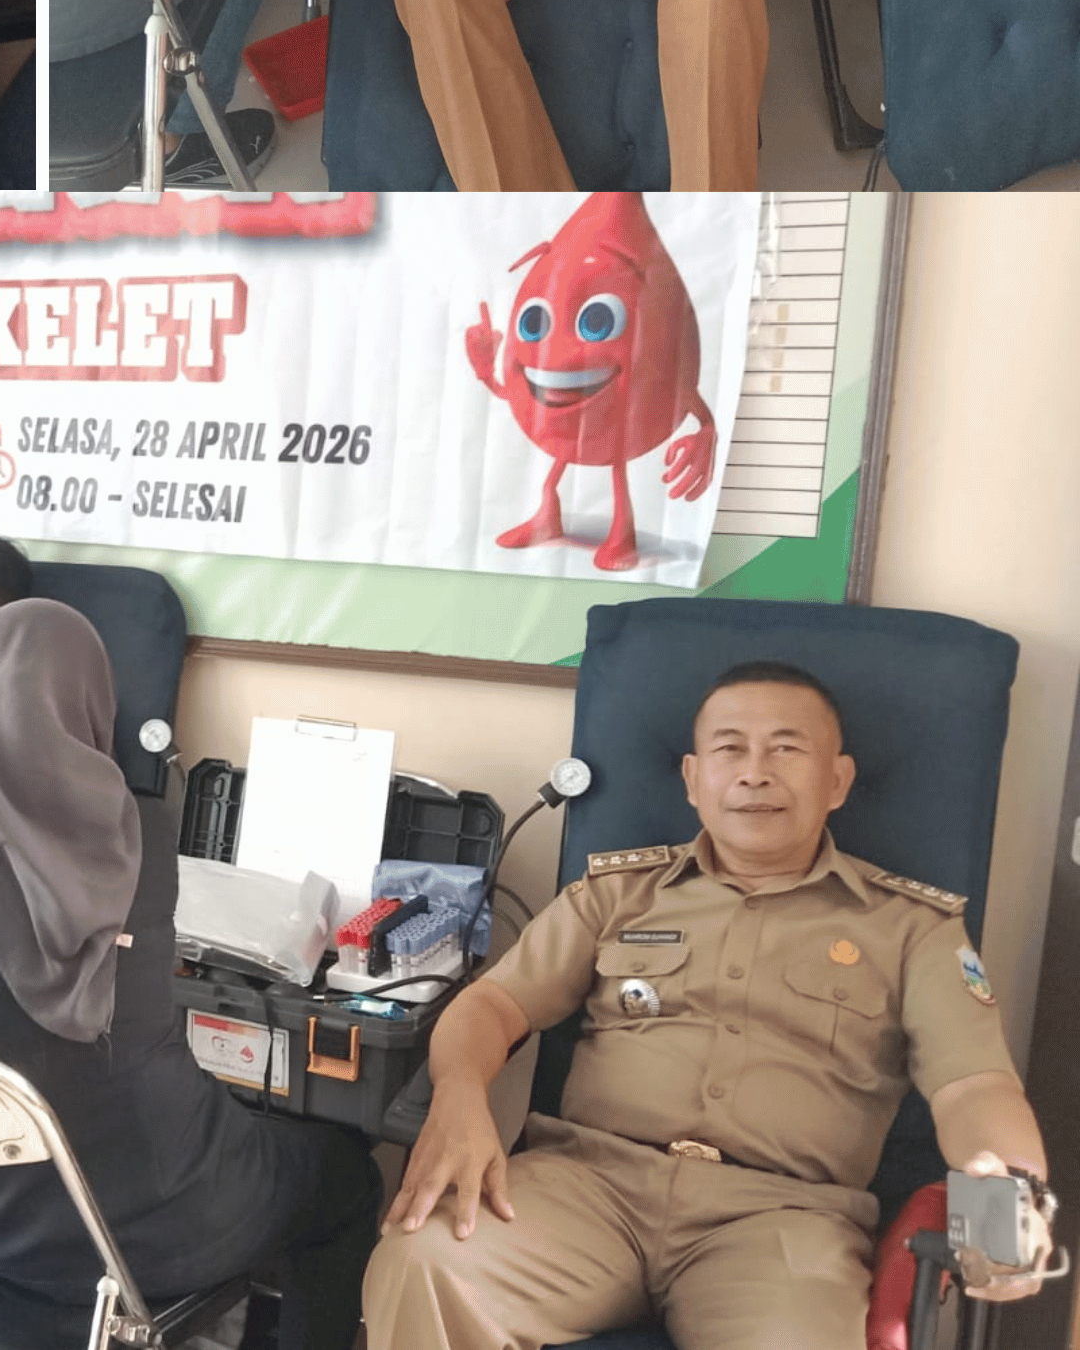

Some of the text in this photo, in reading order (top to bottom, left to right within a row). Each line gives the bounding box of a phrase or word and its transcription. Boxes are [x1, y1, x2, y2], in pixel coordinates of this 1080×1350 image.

[18, 417, 373, 465] SELASA, 28 APRIL 2026
[16, 474, 98, 514] 08.00
[132, 480, 247, 524] SELESAI
